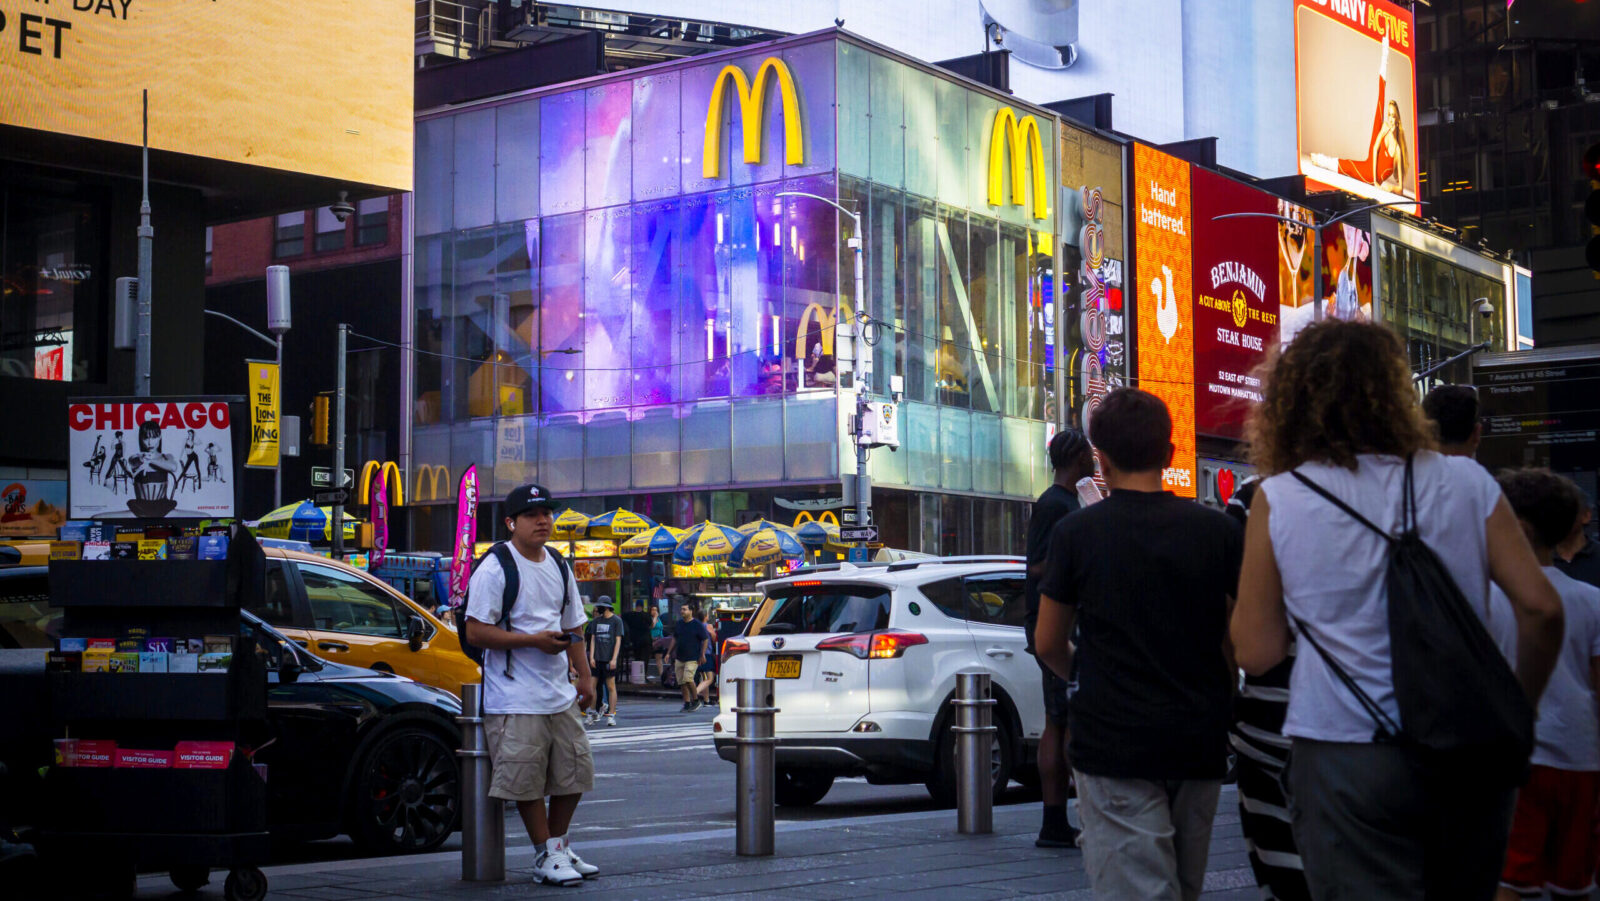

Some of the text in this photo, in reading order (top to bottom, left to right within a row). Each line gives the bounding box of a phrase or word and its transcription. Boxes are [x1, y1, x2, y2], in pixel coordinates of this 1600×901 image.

[1368, 4, 1409, 47] ACTIVE
[1151, 180, 1176, 207] Hand
[1141, 203, 1186, 236] battered.
[1210, 261, 1266, 303] BENJAMIN
[1199, 294, 1276, 325] A CUT ABOVE THE REST
[1217, 327, 1263, 352] STEAK HOUSE
[1225, 372, 1236, 383] EAST
[258, 393, 272, 403] THE
[1208, 383, 1231, 396] MIDTOWN
[70, 403, 230, 431] CHICAGO
[256, 406, 275, 423] LION
[253, 425, 277, 443] KING
[612, 526, 648, 535] SABRETT
[860, 531, 874, 539] WAY
[122, 755, 168, 765] VISITOR GUIDE
[180, 753, 205, 761] VISITOR
[205, 754, 224, 762] GUIDE
